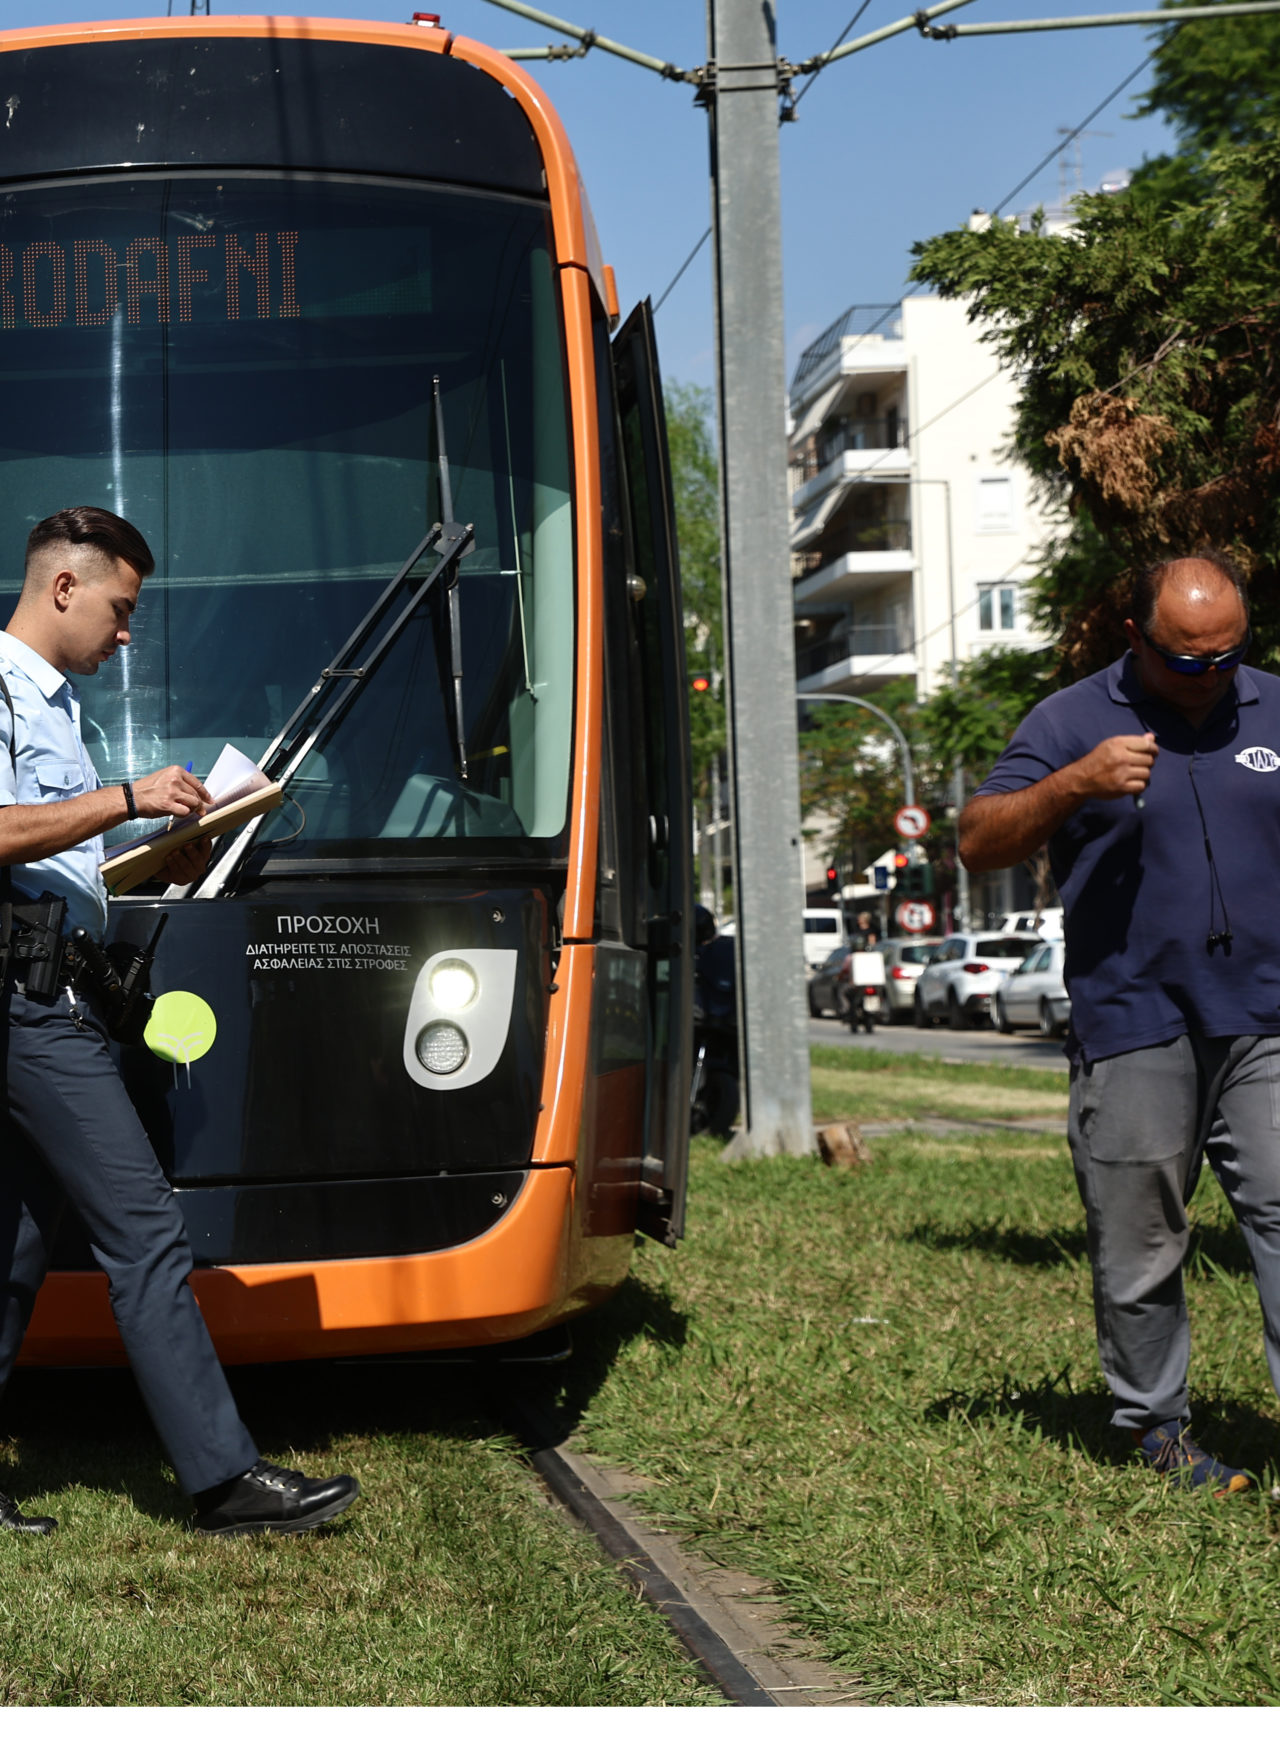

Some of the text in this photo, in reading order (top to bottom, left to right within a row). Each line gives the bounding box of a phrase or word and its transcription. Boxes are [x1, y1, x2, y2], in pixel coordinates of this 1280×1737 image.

[277, 916, 380, 934] ΠΡΟΣΟΧΗ
[246, 943, 412, 957] ΔΙΑΤΗΡΕΙΤΕ ΤΙΣ ΑΠΟΣΤΑΣΕΙΣ
[253, 958, 408, 971] ΑΣΦΑΛΕΙΑΣ ΣΤΙΣ ΣΤΡΟΦΕΣ
